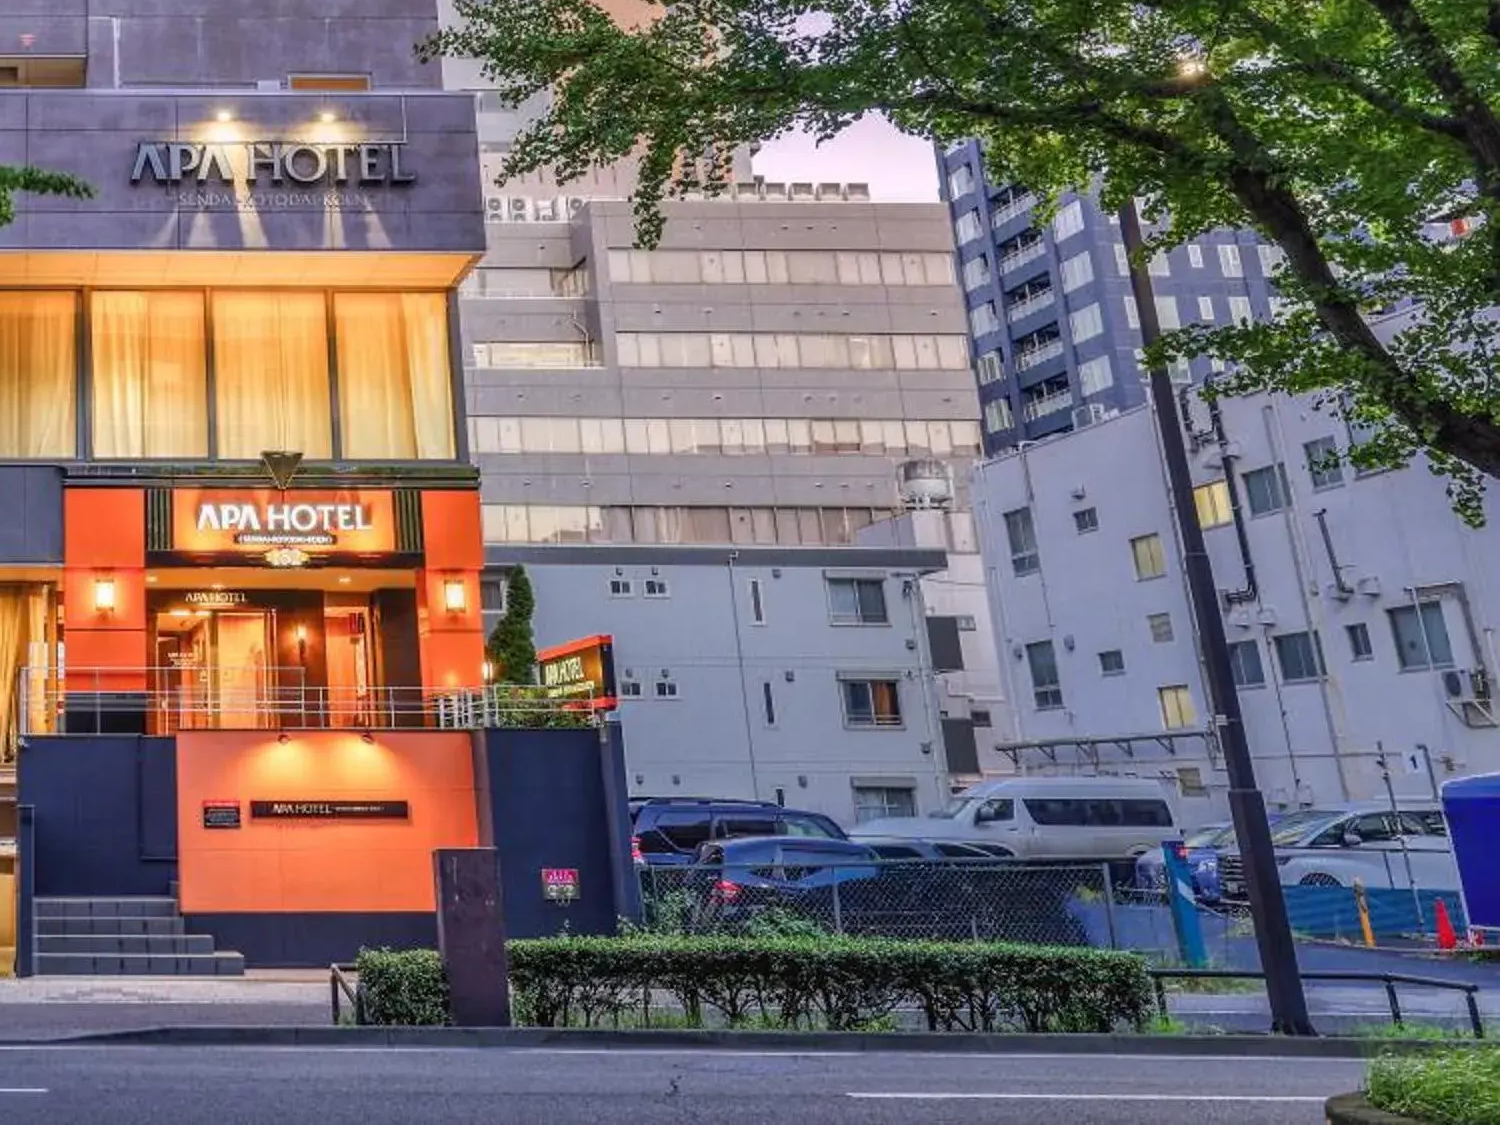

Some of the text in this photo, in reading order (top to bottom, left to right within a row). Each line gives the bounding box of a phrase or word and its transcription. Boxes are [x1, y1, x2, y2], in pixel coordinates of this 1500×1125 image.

[131, 142, 417, 183] APA HOTEL
[197, 504, 373, 531] APA HOTEL
[185, 592, 245, 603] APA HOTEL
[272, 803, 296, 814] APA
[298, 803, 331, 814] HOTEL
